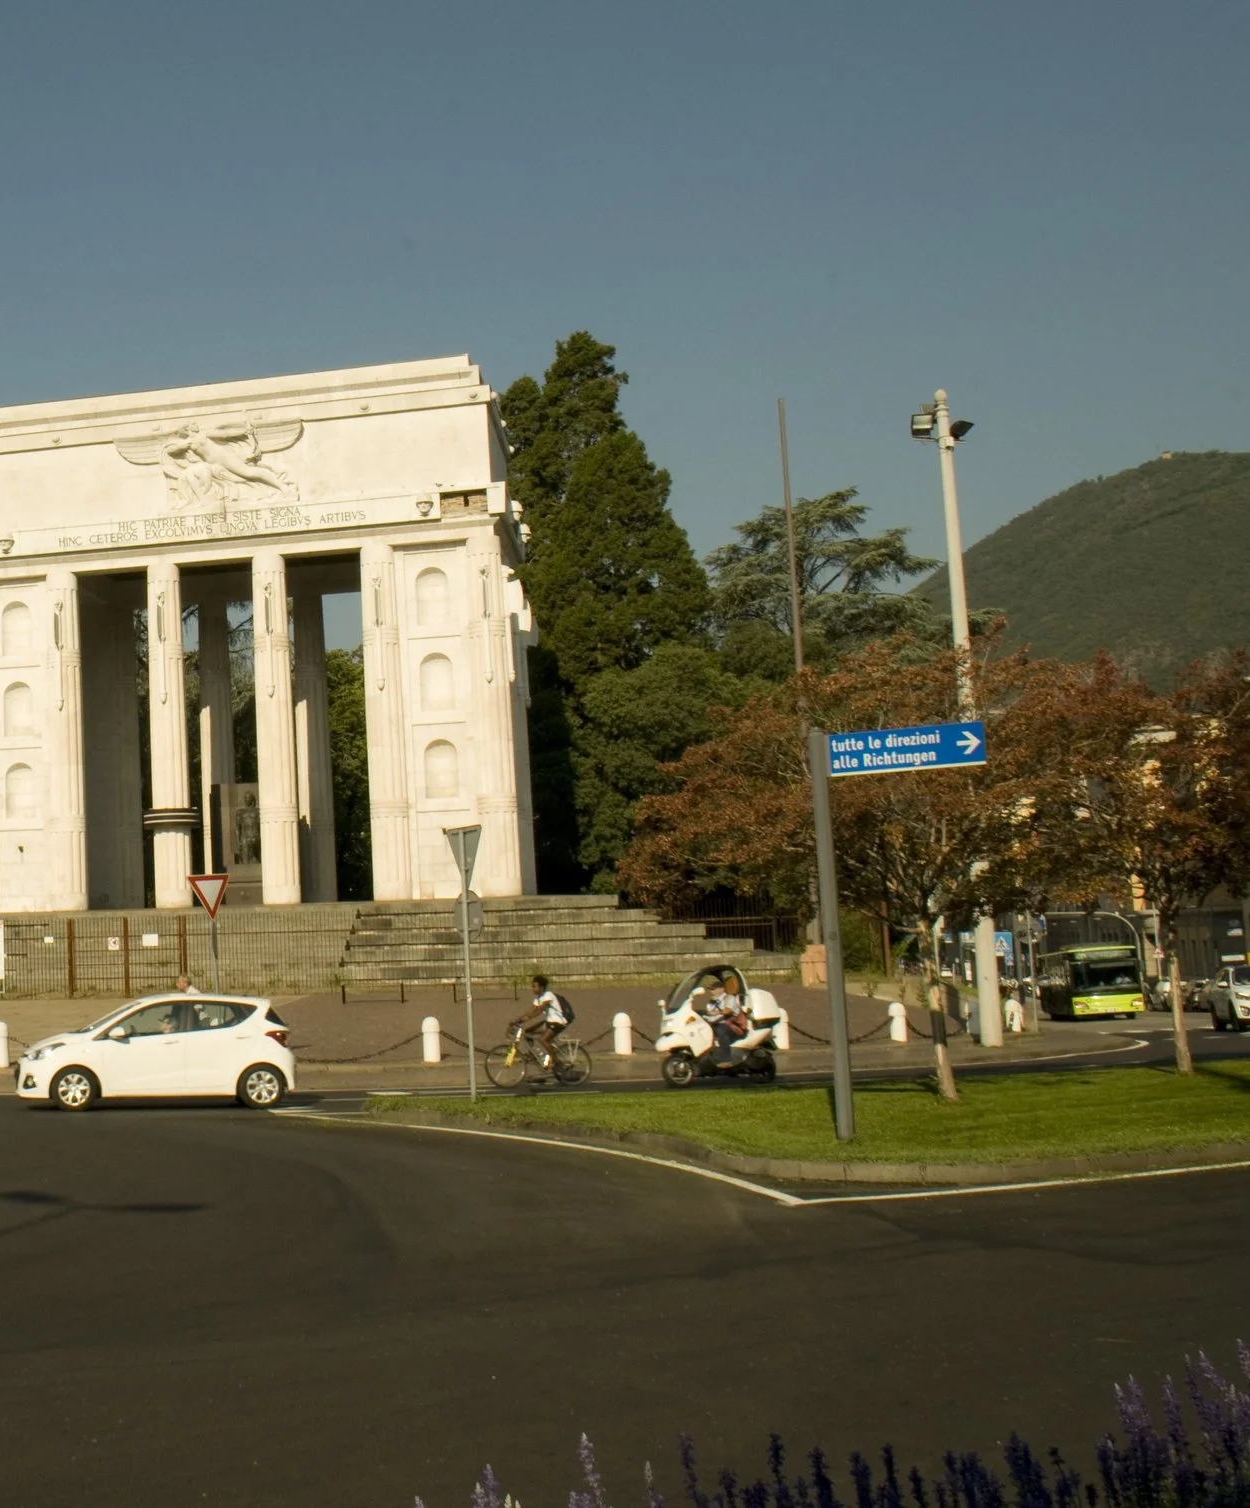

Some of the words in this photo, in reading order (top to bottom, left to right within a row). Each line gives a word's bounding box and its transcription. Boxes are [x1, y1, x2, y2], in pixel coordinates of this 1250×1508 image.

[58, 536, 82, 547] HINC
[89, 532, 138, 544] CETEROS
[145, 525, 213, 540] EXCOLVIMVS
[319, 510, 366, 524] ARTIBVS
[118, 521, 138, 532] HIC
[144, 517, 186, 530] PATRIAE
[194, 512, 225, 525] FINES
[233, 509, 262, 522] SISTE
[269, 507, 301, 519] SIGNA
[831, 738, 864, 752] tutte
[868, 736, 881, 749] le
[885, 730, 940, 748] direzioni
[833, 755, 858, 769] alle
[863, 751, 936, 767] Richtungen
